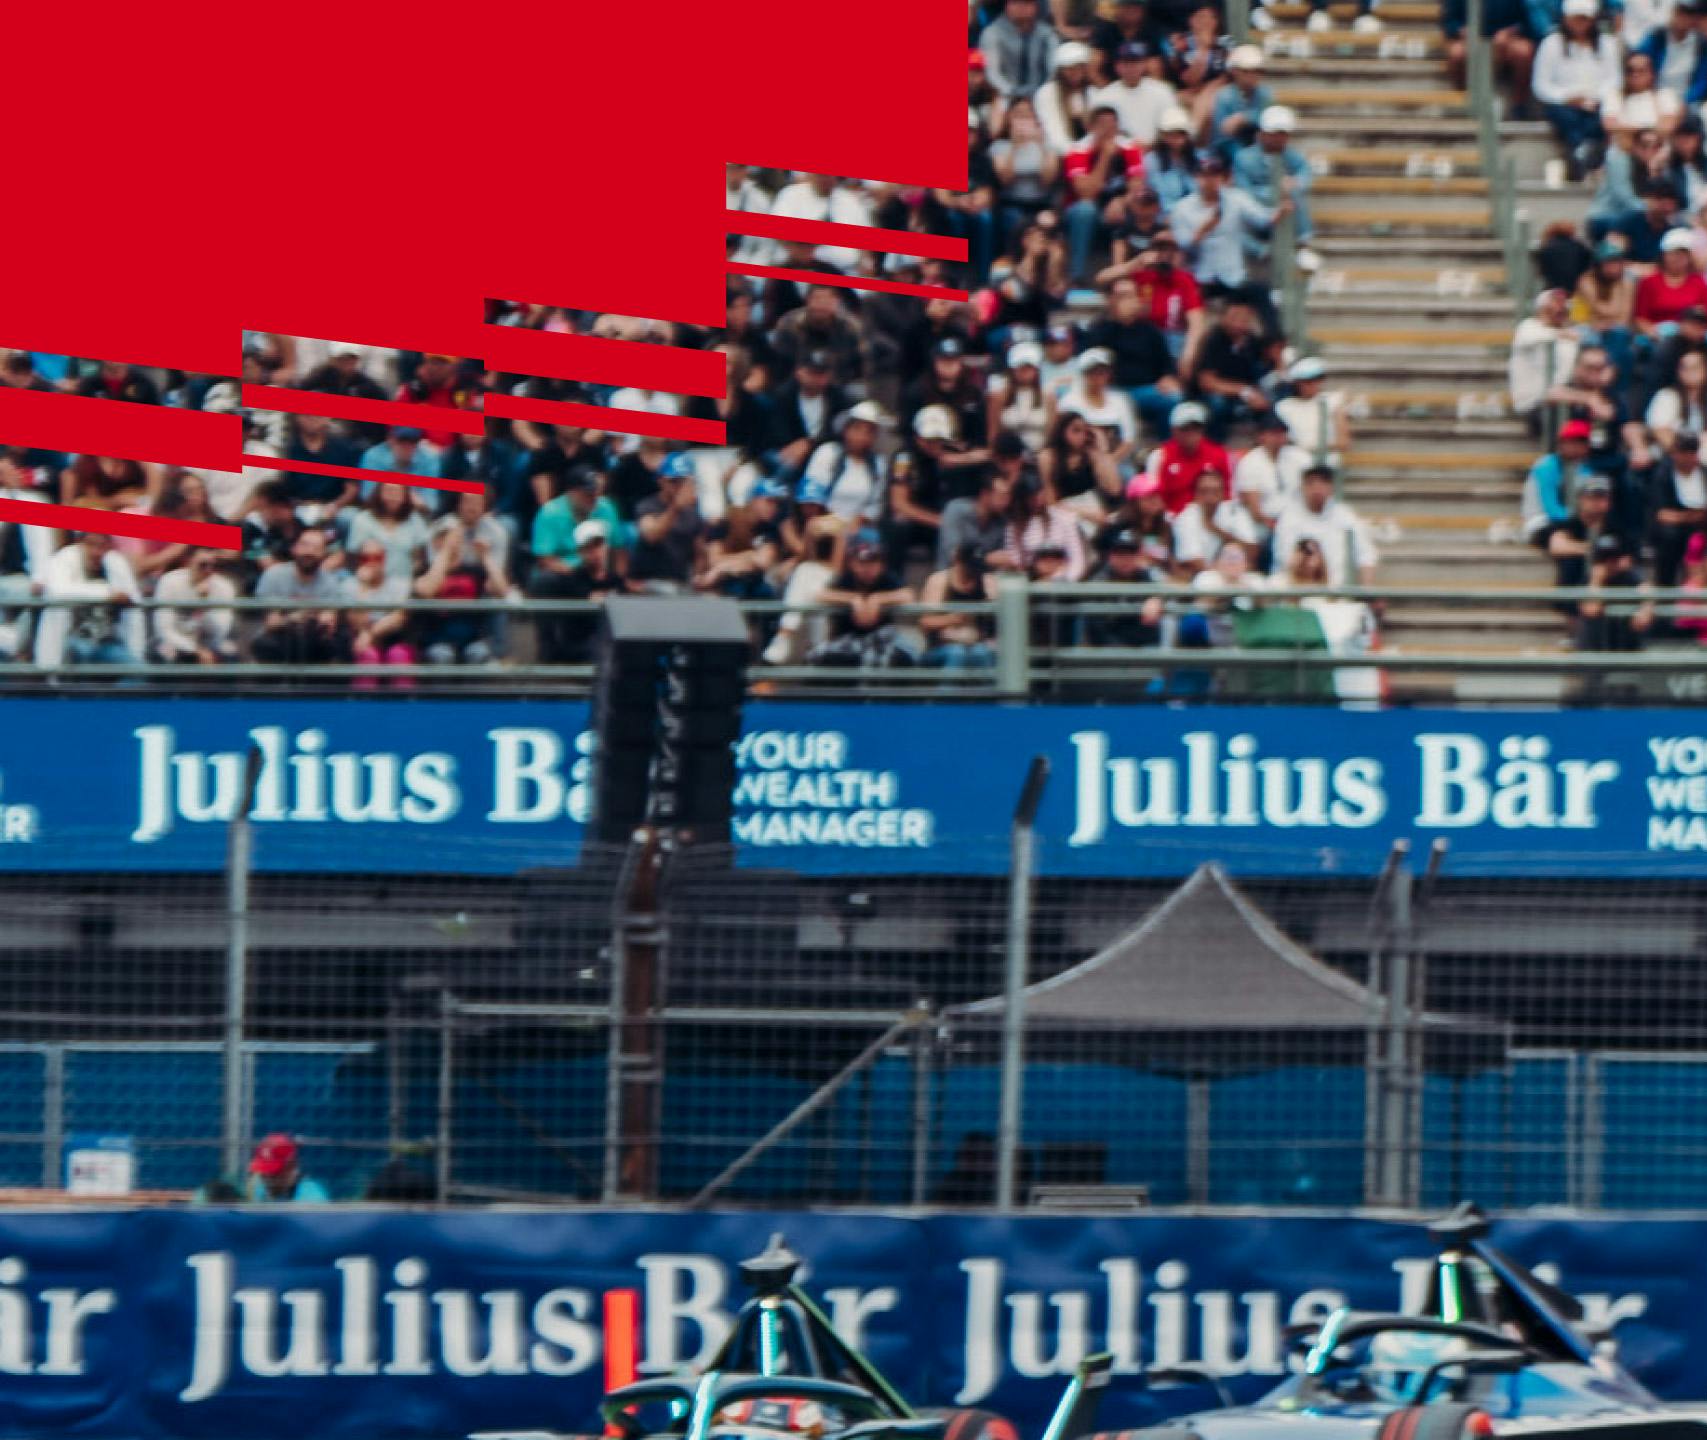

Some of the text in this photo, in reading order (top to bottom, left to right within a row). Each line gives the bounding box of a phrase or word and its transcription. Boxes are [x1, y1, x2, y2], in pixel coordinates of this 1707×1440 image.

[131, 724, 463, 843] Julius
[488, 728, 597, 825] Bä
[730, 731, 846, 769] YOUR
[732, 769, 899, 808] WEALTH
[1069, 730, 1617, 846] Julius Bär
[731, 808, 936, 847] MANAGER
[179, 1252, 899, 1401] Julius Br
